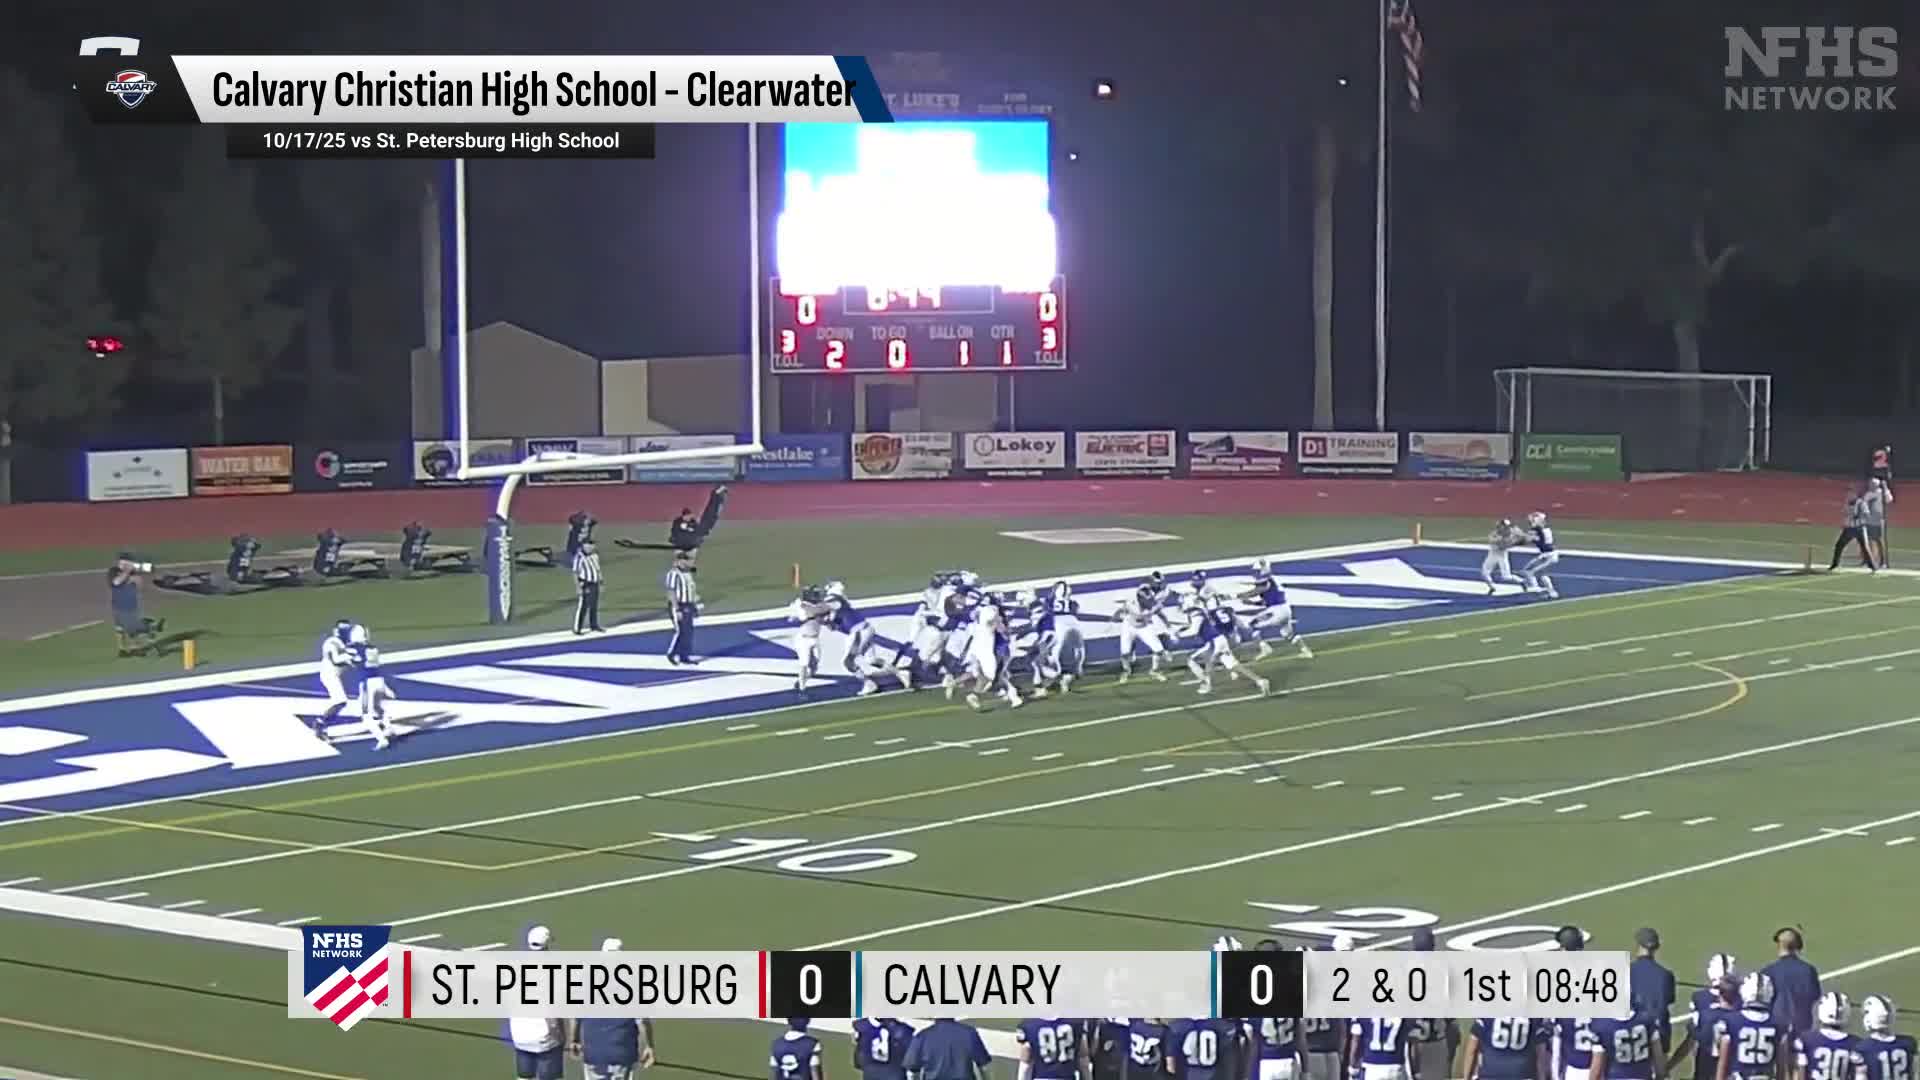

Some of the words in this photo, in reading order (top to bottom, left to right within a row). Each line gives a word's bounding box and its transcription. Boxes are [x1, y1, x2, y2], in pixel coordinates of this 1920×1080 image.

[798, 297, 816, 324] 0
[1040, 293, 1057, 322] 0
[782, 330, 795, 353] 3
[817, 327, 853, 339] DOWN
[1043, 327, 1056, 350] 3
[827, 340, 844, 368] 2
[889, 340, 906, 368] 0
[960, 340, 969, 366] 1
[1003, 340, 1012, 366] 1
[997, 438, 1057, 454] Lokey
[1304, 439, 1326, 455] D1
[1329, 437, 1396, 449] TRAINING
[201, 457, 249, 474] WATER
[688, 838, 918, 873] 10
[1369, 1018, 1402, 1051] 17
[1737, 1027, 1776, 1064] 25
